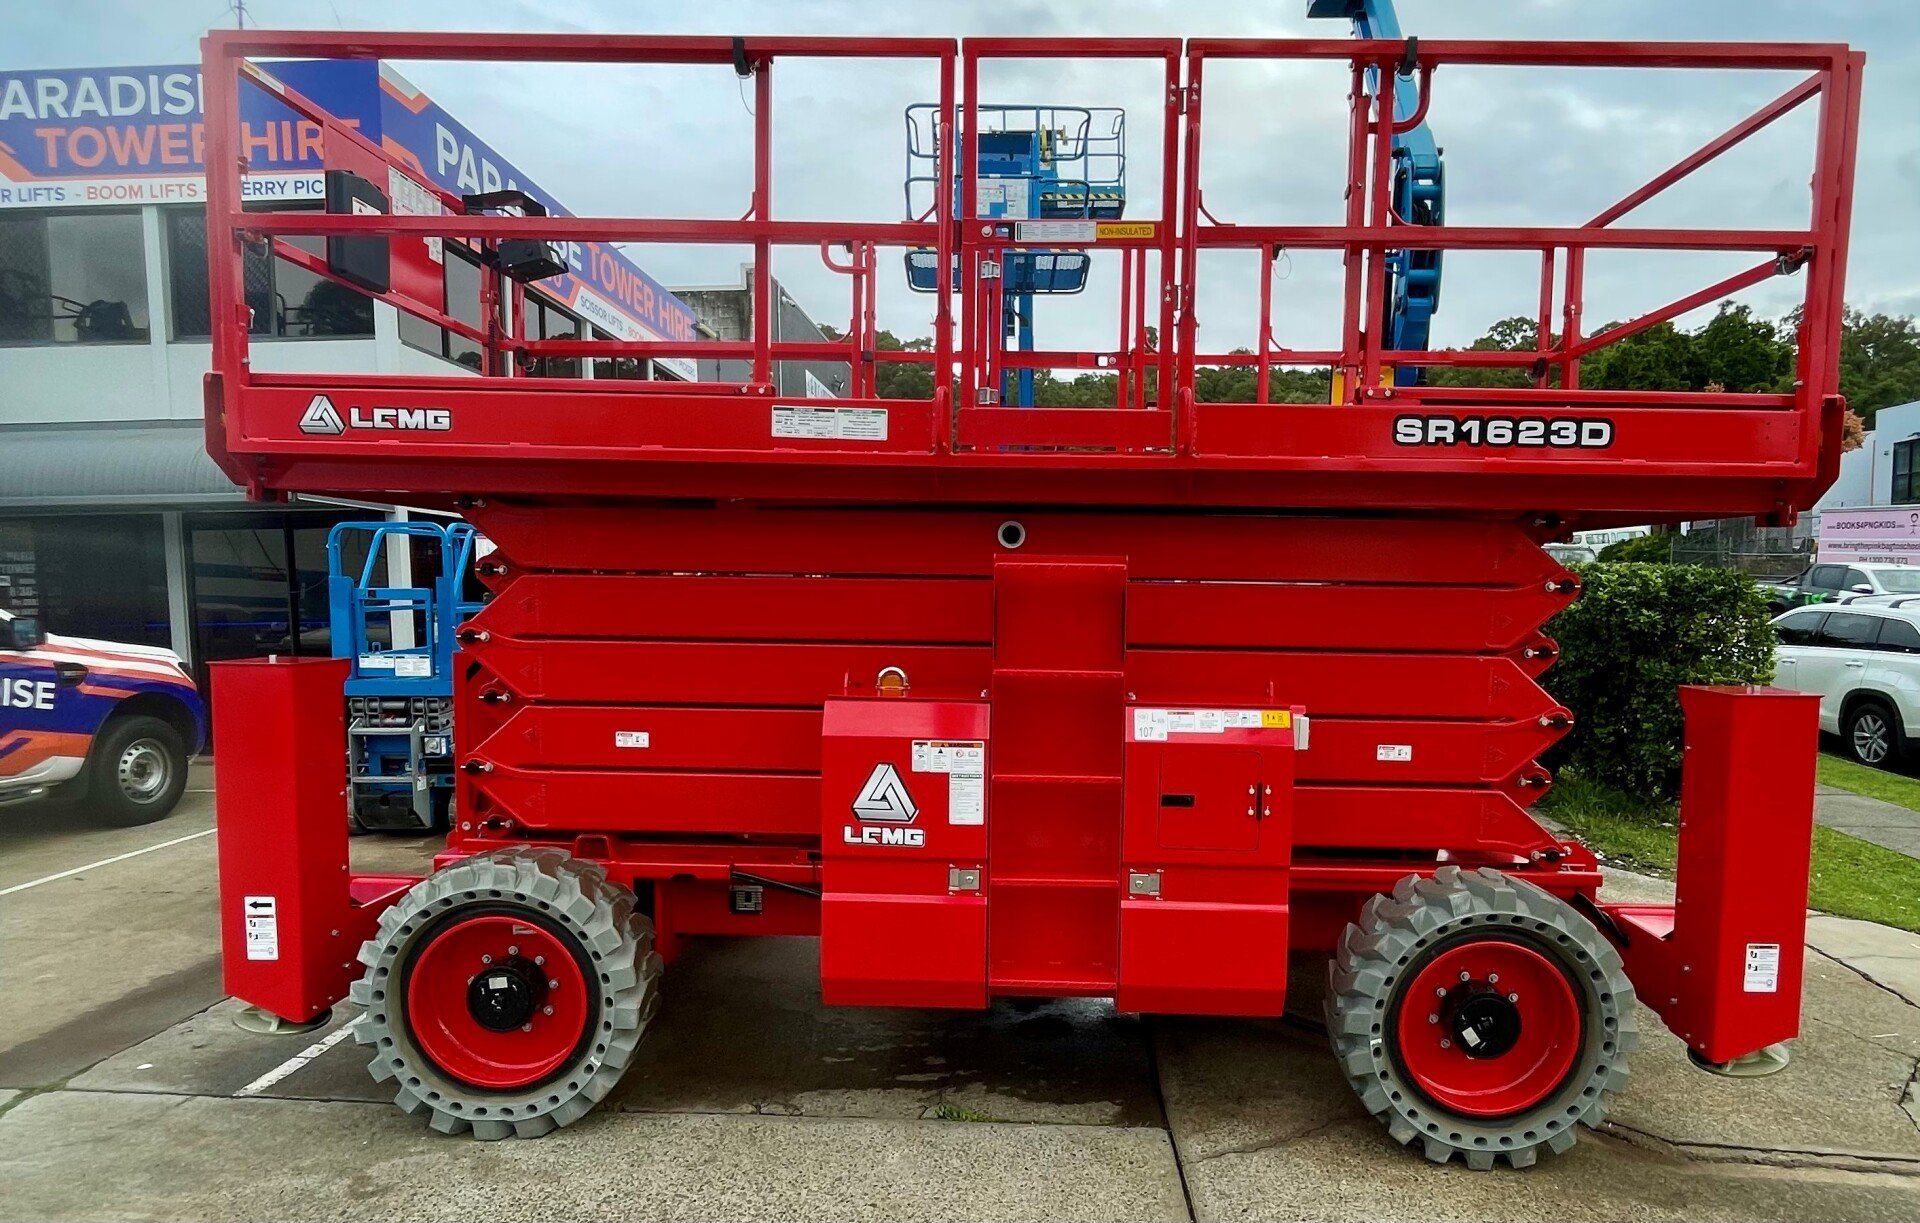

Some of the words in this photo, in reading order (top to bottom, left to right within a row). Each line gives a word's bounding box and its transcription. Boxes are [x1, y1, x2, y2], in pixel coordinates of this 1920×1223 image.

[0, 73, 204, 120] ARADIS
[241, 119, 360, 162] HIR
[18, 187, 66, 203] LIFTS
[86, 184, 146, 201] BOOM
[150, 182, 197, 199] LIFTS
[242, 180, 287, 196] ERRY
[1099, 226, 1152, 236] NON-INSULATED
[588, 241, 655, 321] TOWER
[659, 296, 694, 342] HIRE
[580, 295, 609, 322] SCISSOR
[608, 313, 624, 331] LIFTS
[1396, 418, 1611, 446] SR1623D
[3, 678, 56, 710] ISE
[1139, 726, 1154, 738] 107
